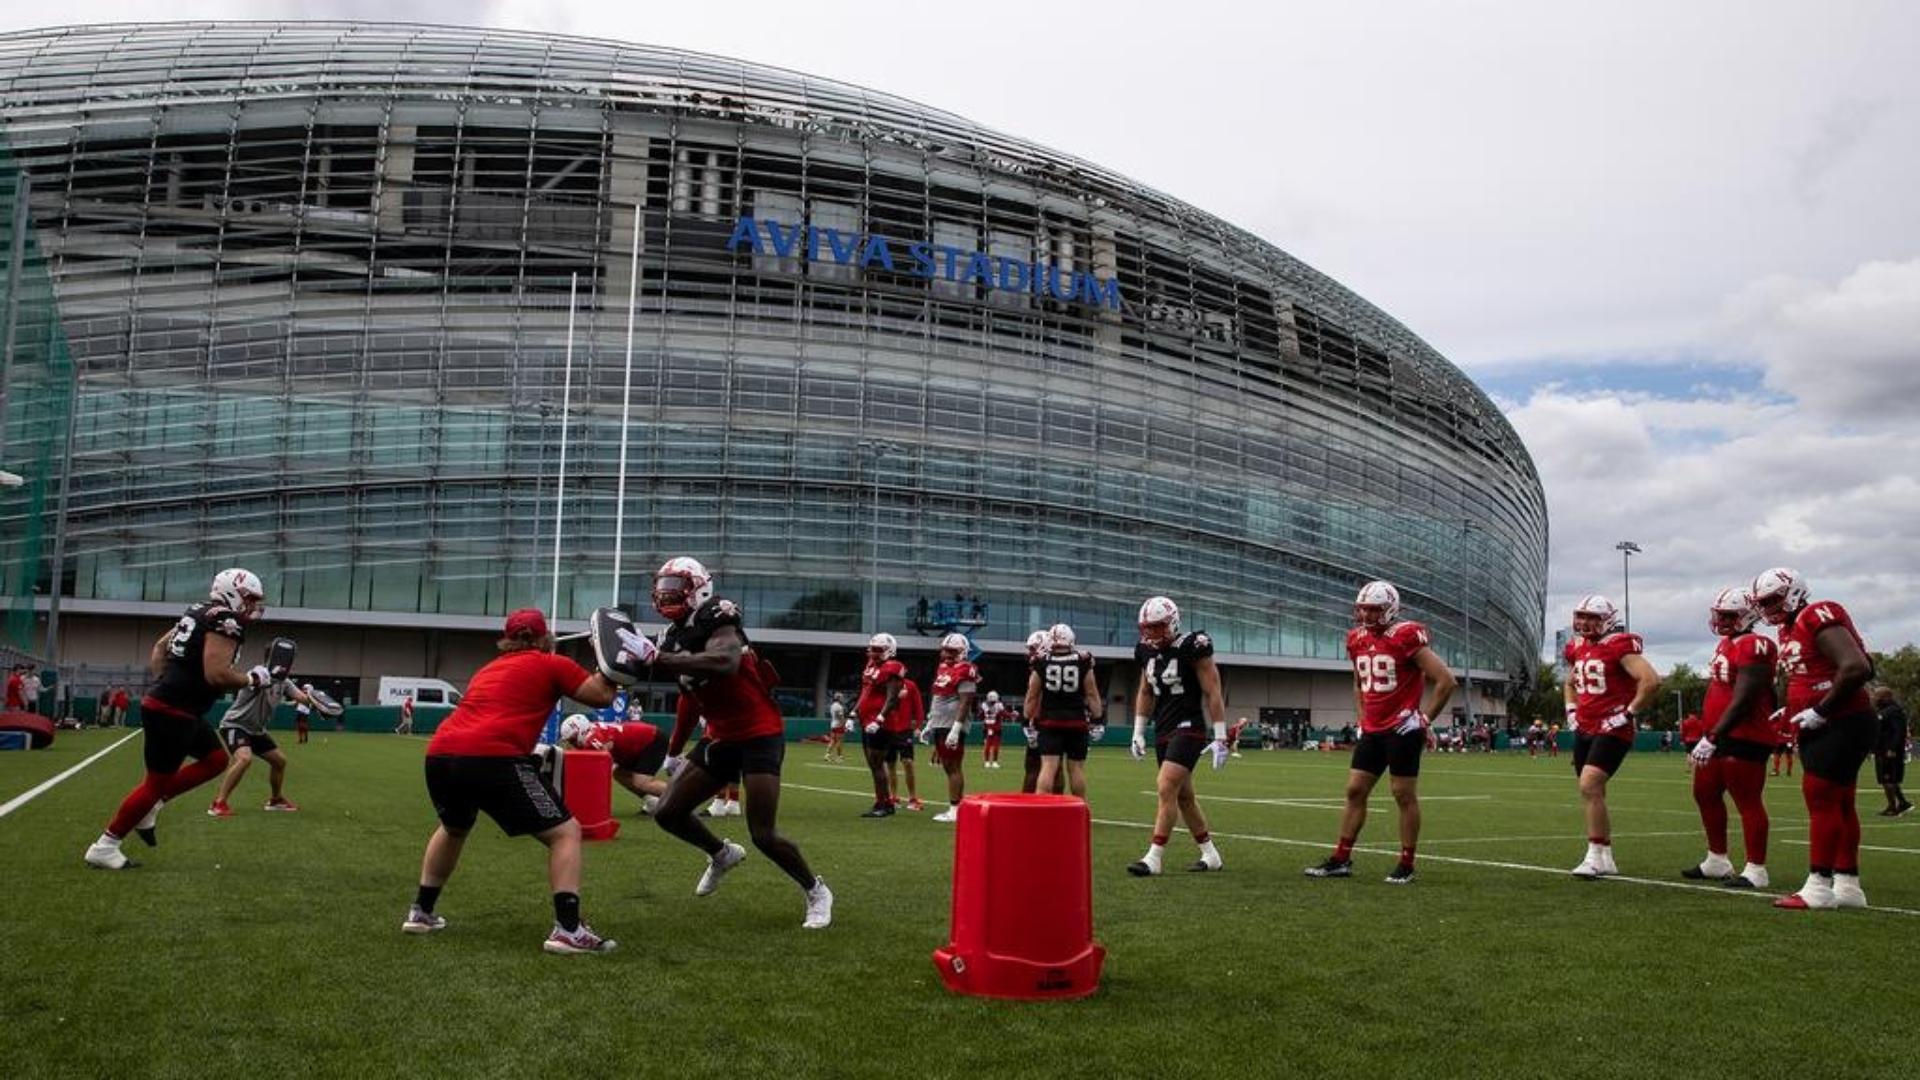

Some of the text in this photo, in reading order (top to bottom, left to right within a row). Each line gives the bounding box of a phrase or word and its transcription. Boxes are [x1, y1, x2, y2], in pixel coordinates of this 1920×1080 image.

[726, 215, 1121, 312] AVIVA STADIUM
[1814, 604, 1835, 622] N
[1755, 640, 1768, 655] N
[1045, 664, 1079, 693] 99
[1146, 657, 1184, 696] 44
[1356, 654, 1397, 692] 99
